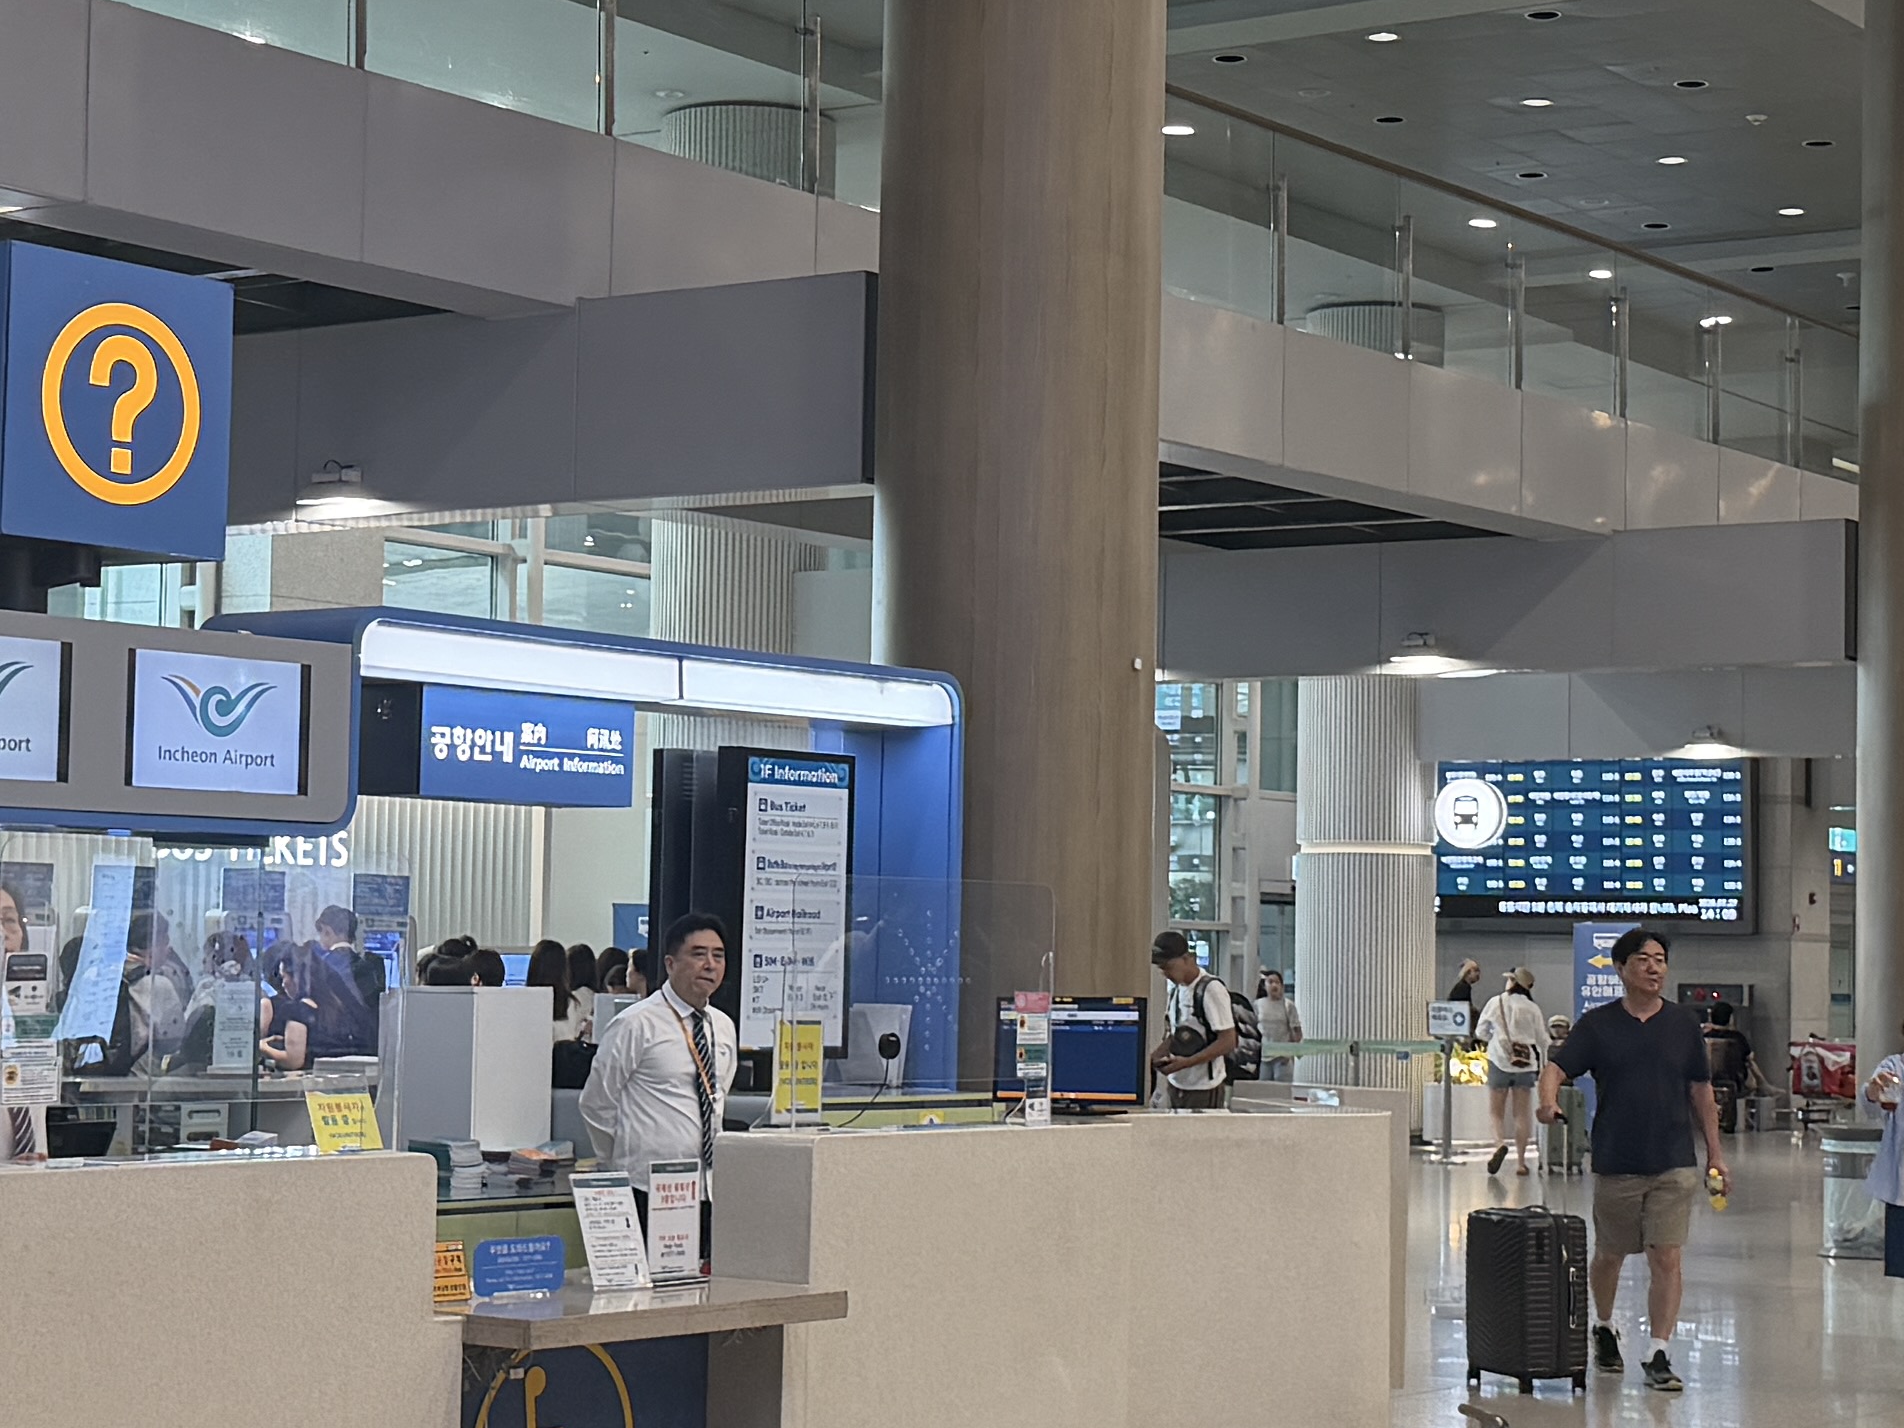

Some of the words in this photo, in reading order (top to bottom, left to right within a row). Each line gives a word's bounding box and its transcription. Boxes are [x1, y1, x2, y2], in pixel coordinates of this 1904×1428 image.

[430, 725, 515, 763] 공항안내
[157, 744, 218, 765] Incheon
[222, 748, 276, 769] Airport
[519, 754, 560, 773] Airport
[563, 756, 625, 775] Information
[760, 763, 773, 778] 1F
[774, 765, 839, 783] Information
